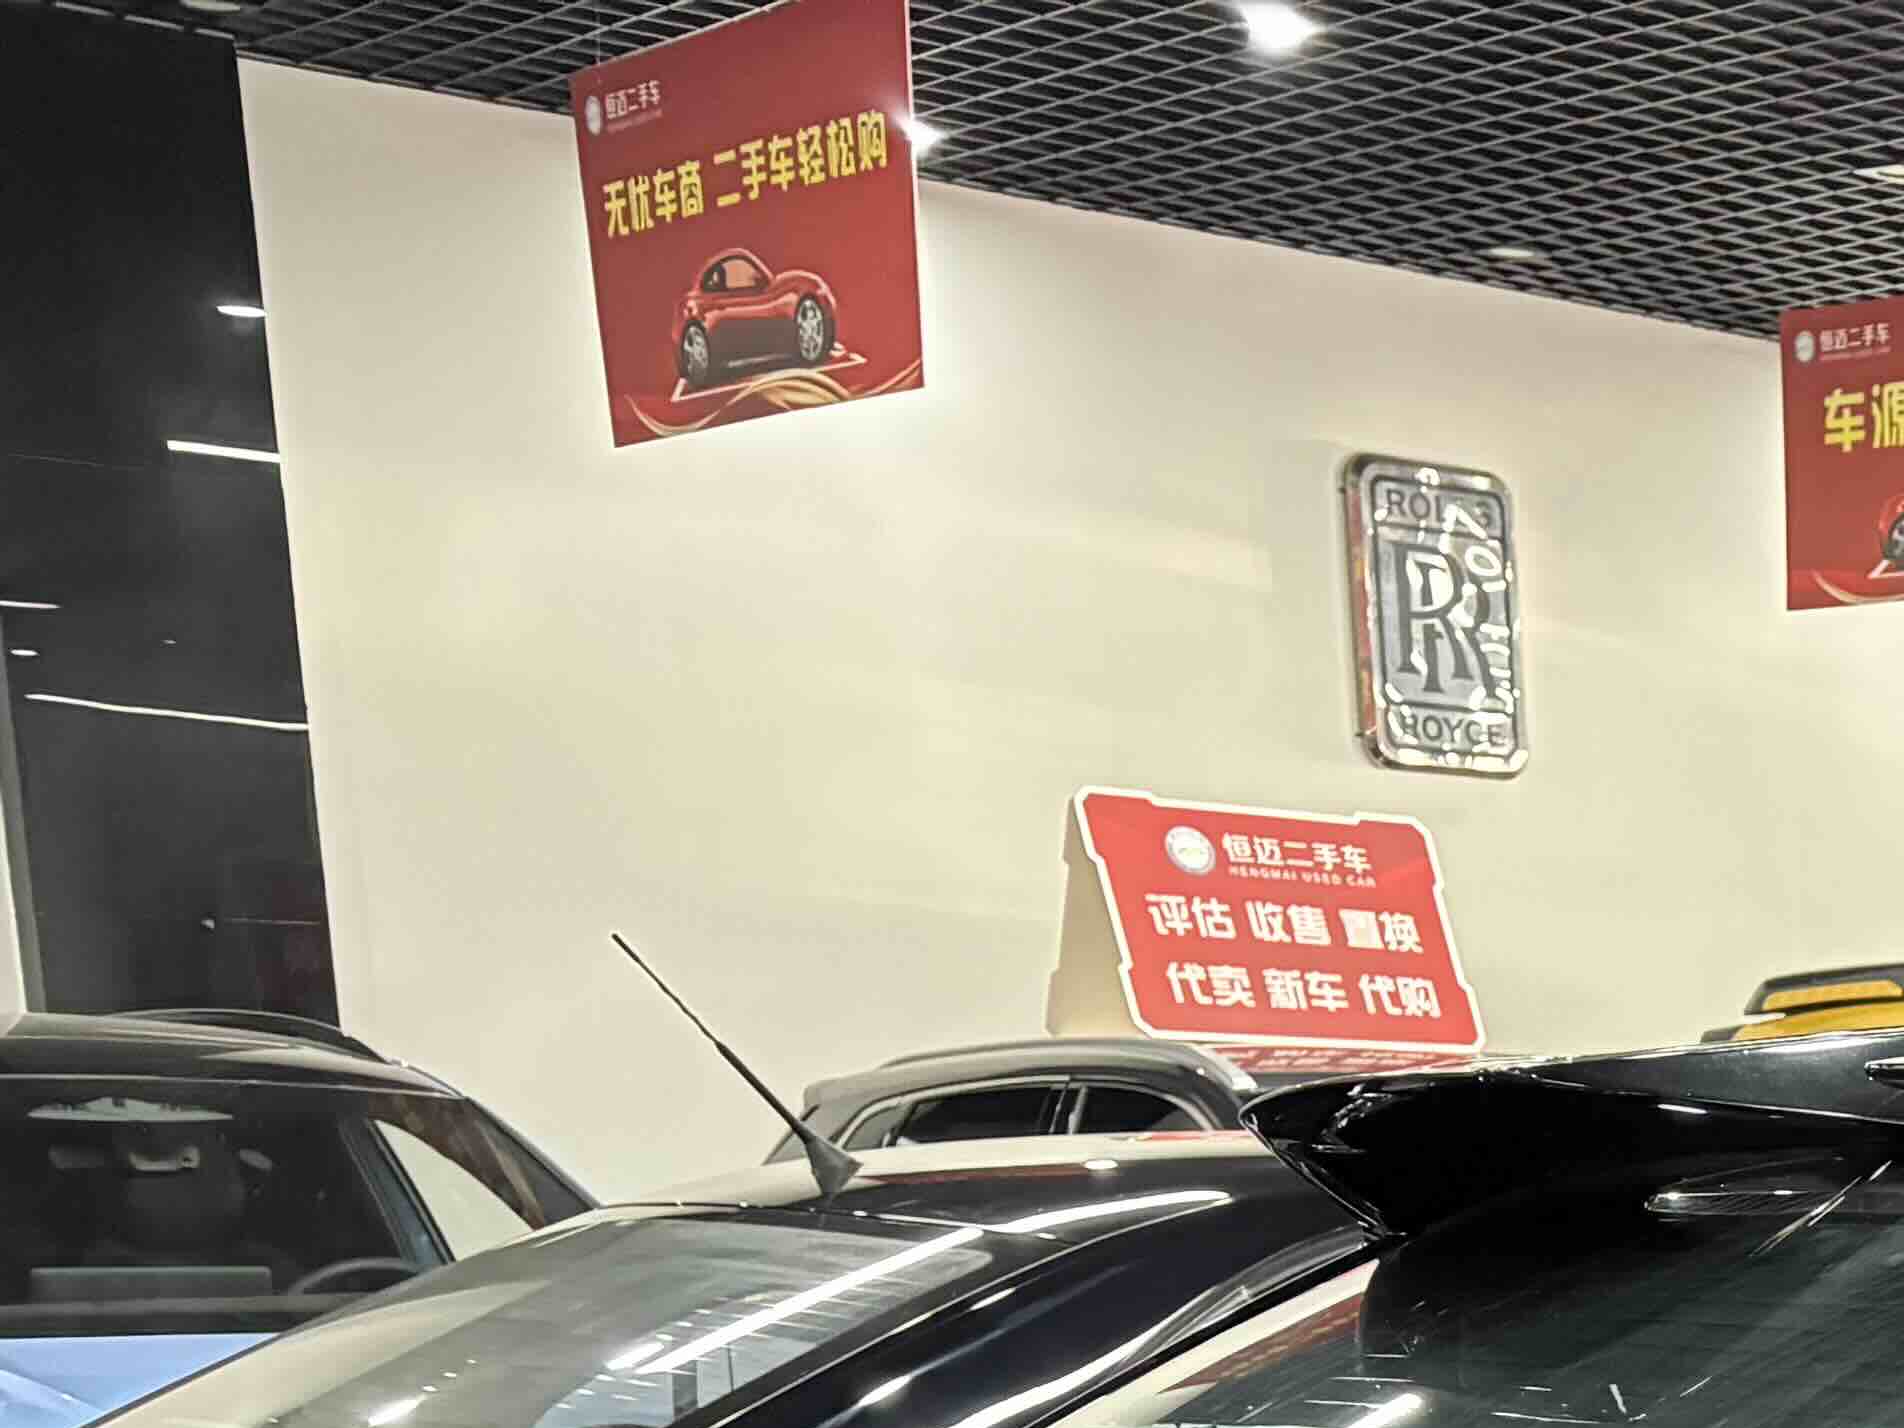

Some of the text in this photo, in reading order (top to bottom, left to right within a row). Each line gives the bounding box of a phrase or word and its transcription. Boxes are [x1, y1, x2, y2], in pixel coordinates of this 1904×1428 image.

[603, 109, 888, 238] 无忧车商 二手车轻松购
[1222, 832, 1372, 874] 恒迈二手车
[1144, 893, 1424, 953] 评估 收售 置换
[1166, 961, 1441, 1019] 代卖 新车 代购
